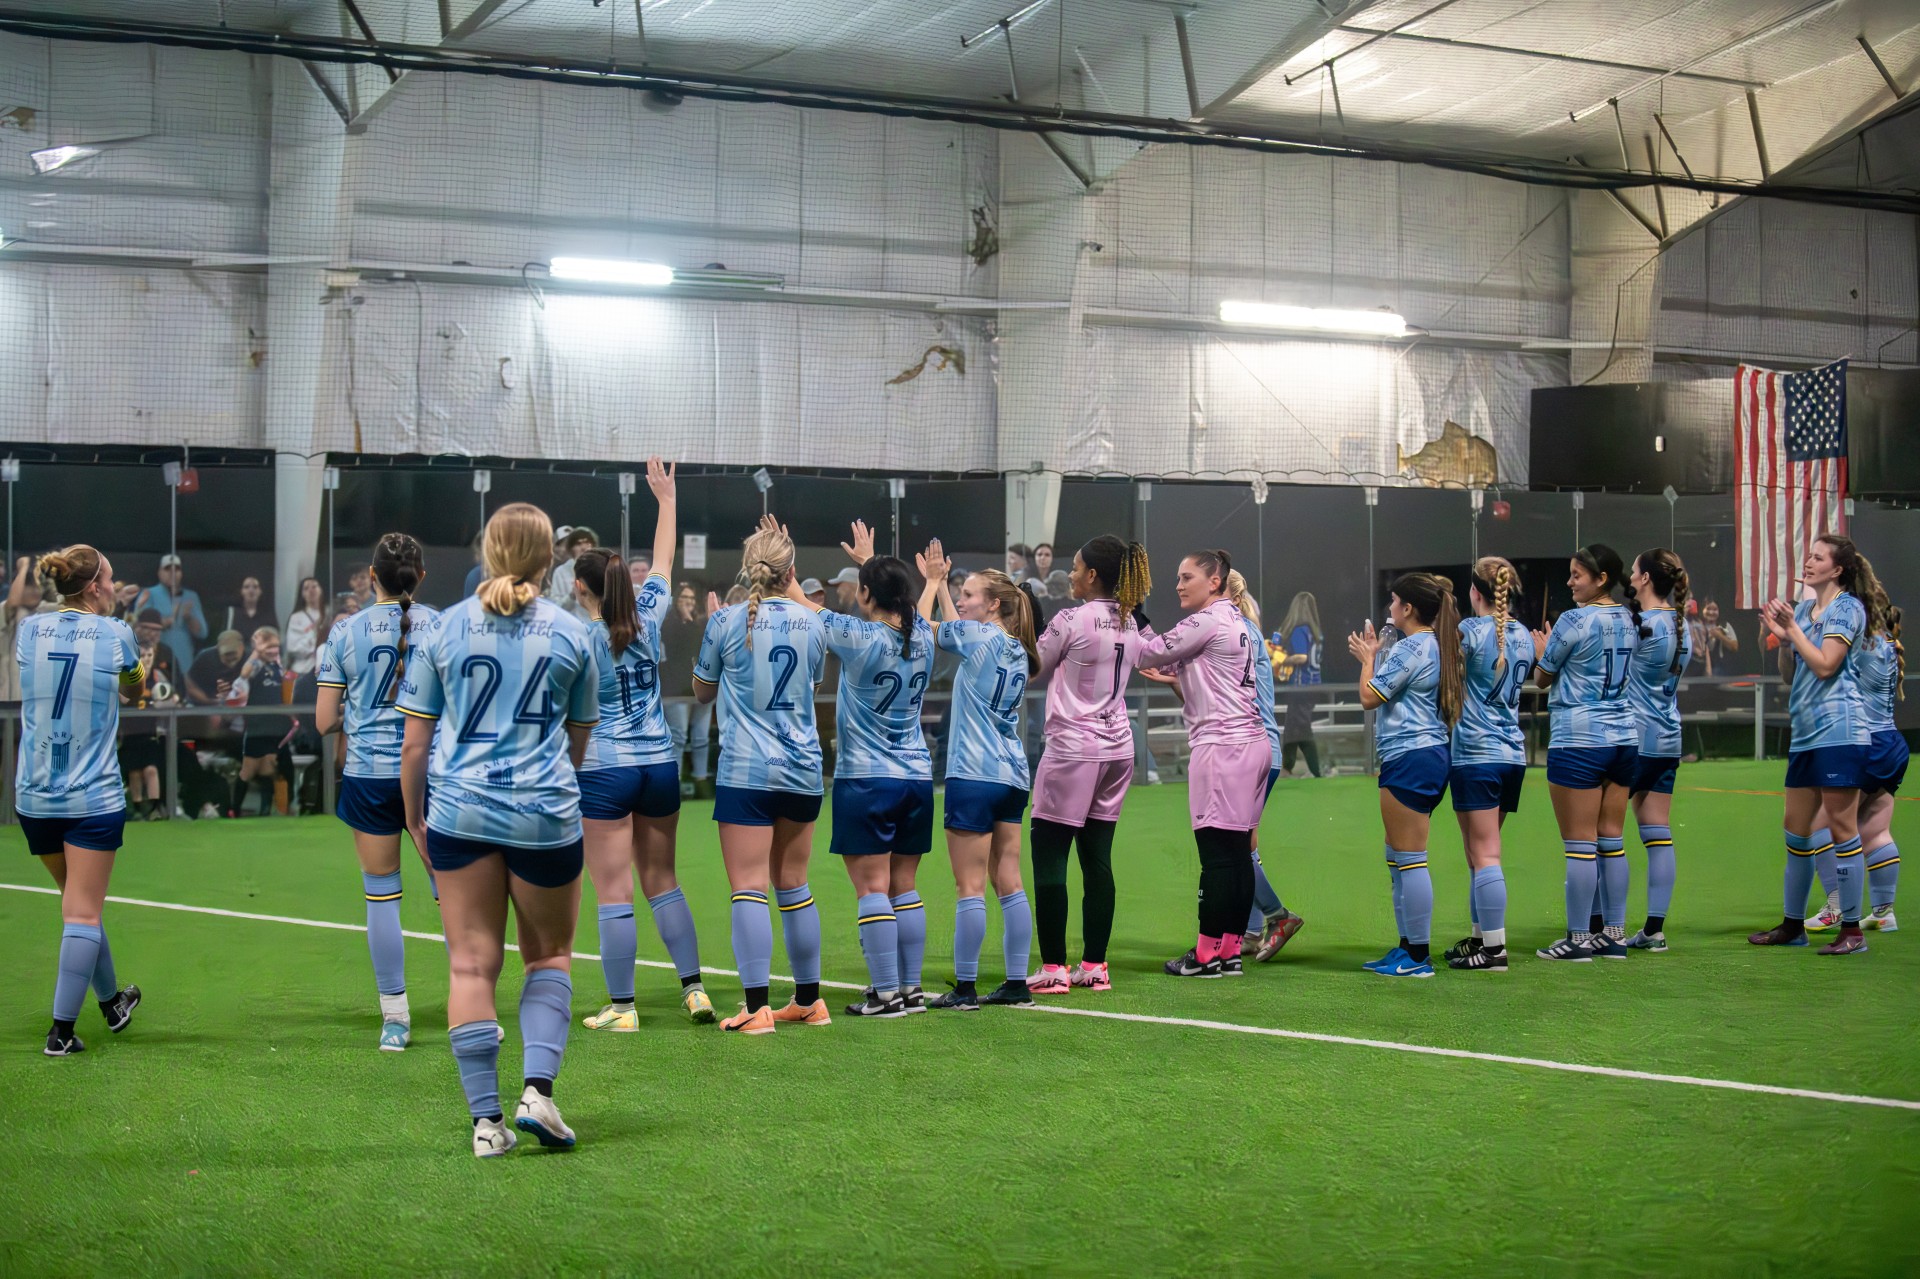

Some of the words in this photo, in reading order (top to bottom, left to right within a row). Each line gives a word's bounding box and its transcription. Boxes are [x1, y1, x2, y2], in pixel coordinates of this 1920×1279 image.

[47, 651, 80, 720] 7
[457, 654, 553, 745] 24
[614, 659, 658, 717] 19
[765, 644, 798, 711] 2
[992, 666, 1026, 723] 12
[1111, 642, 1124, 700] 1
[1482, 660, 1530, 709] 28
[1601, 648, 1632, 701] 17
